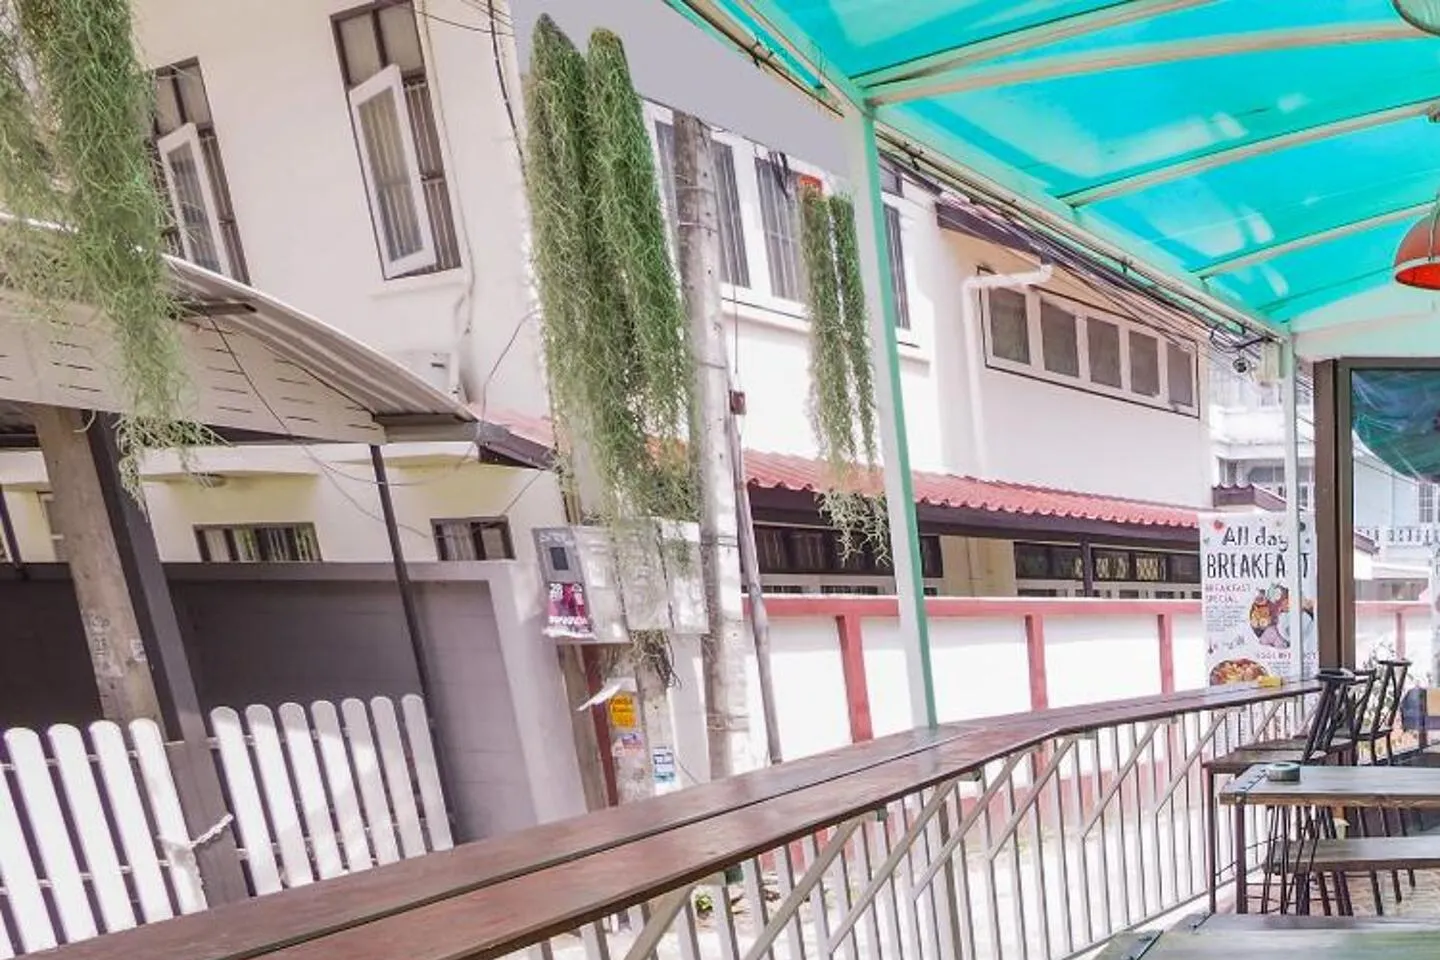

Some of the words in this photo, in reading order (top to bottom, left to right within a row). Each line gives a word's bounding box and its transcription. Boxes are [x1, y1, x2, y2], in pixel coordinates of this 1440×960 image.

[1222, 526, 1249, 546] All
[1255, 526, 1289, 552] day
[1206, 553, 1309, 578] BREAKFAT
